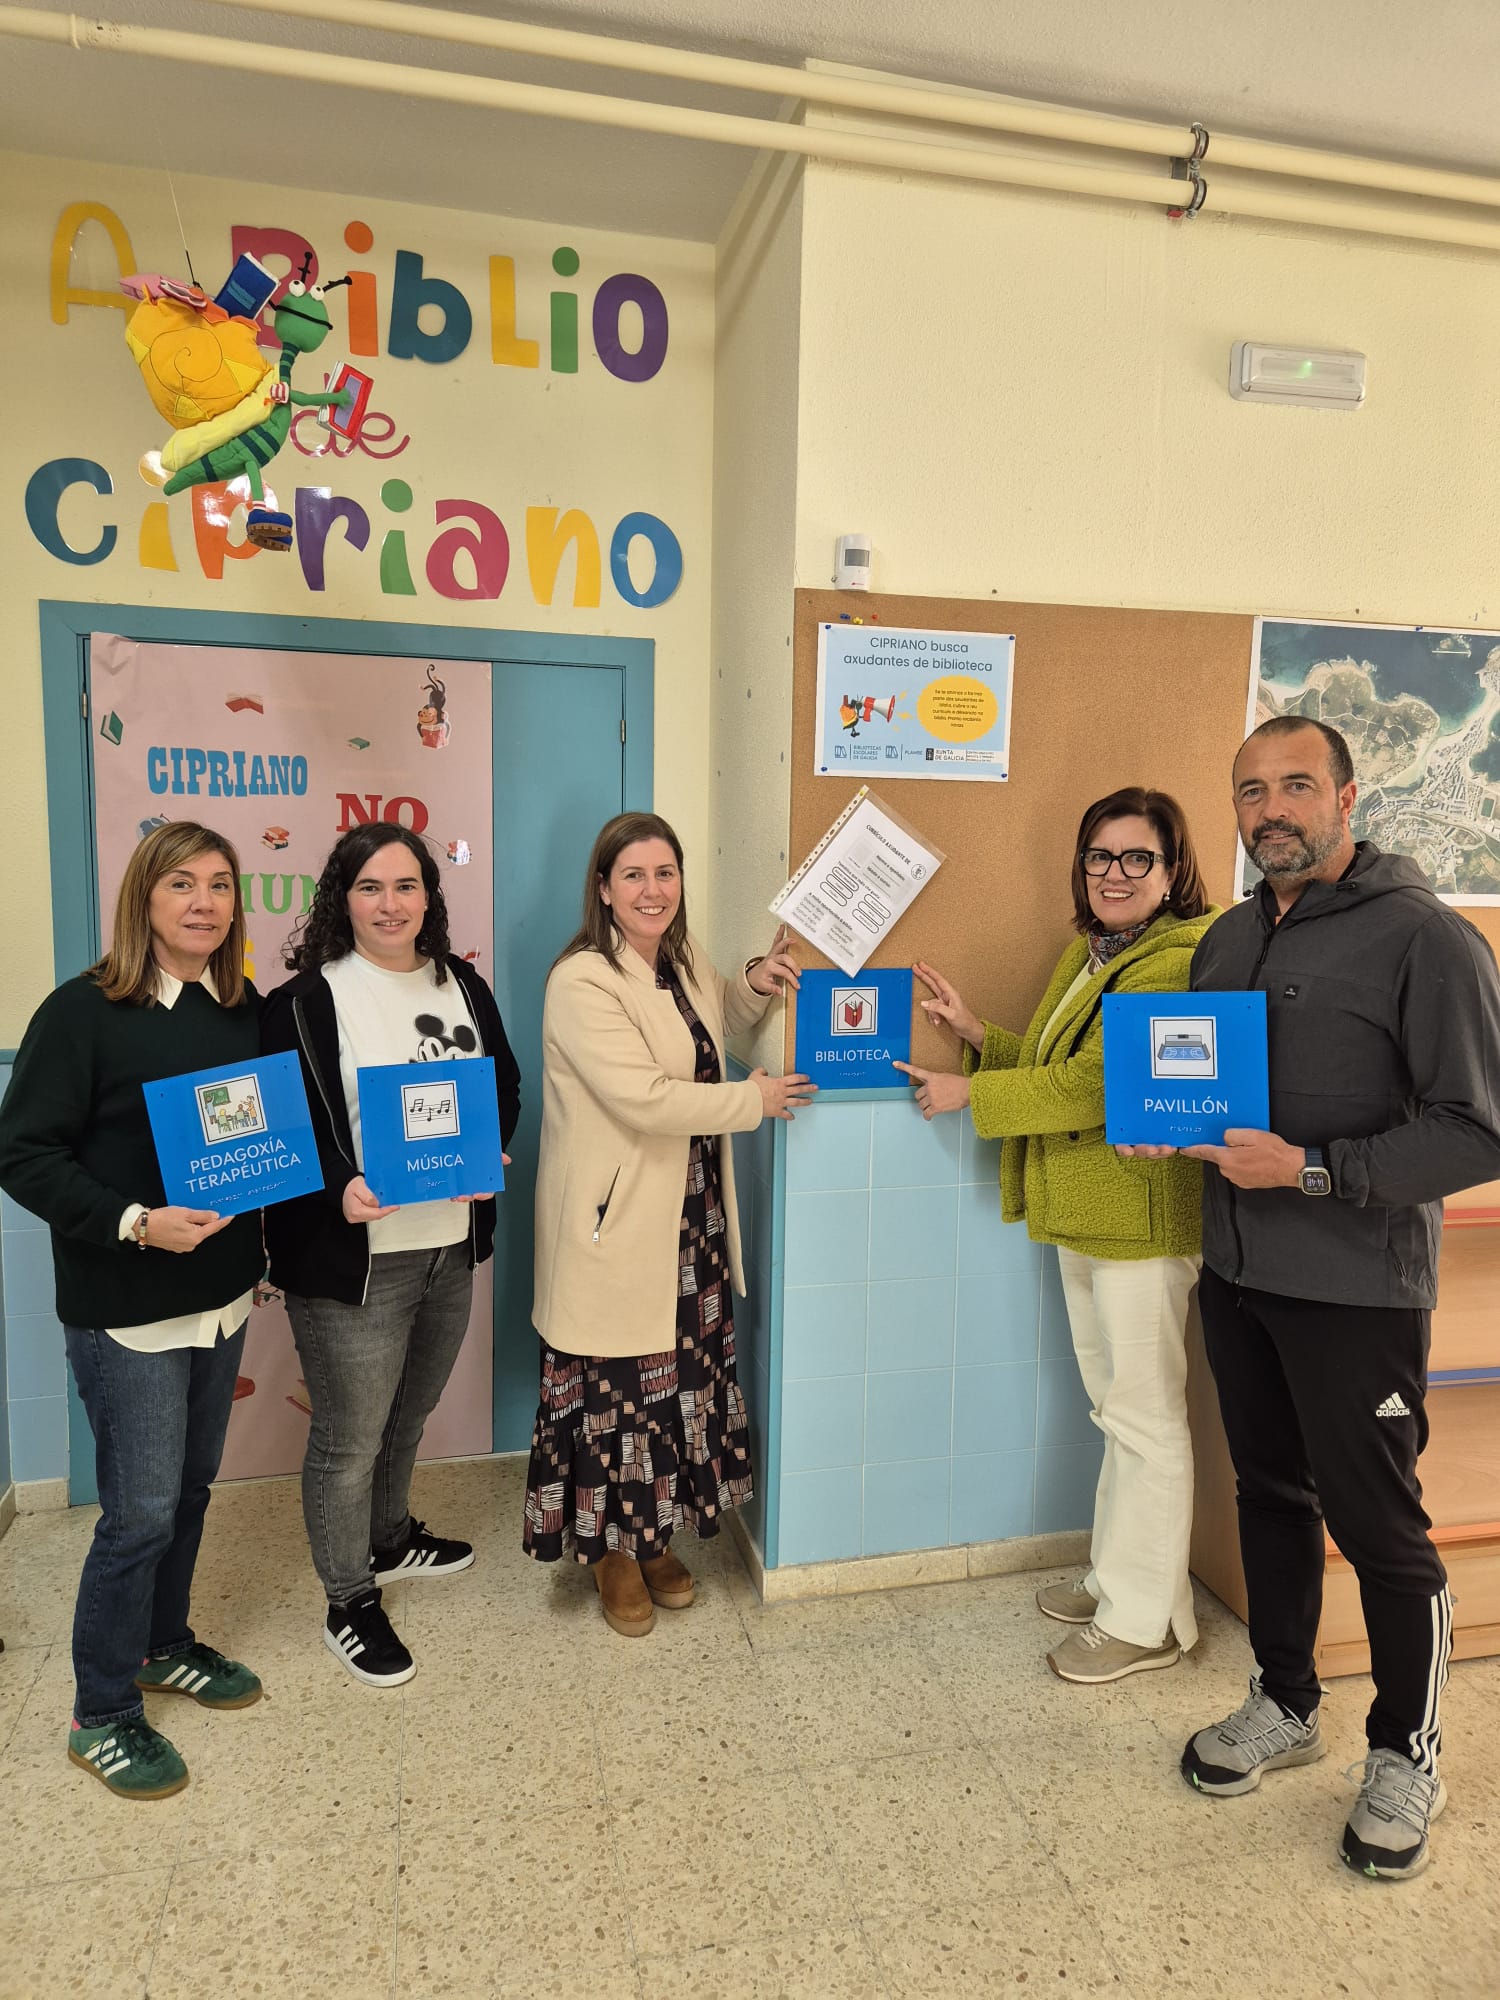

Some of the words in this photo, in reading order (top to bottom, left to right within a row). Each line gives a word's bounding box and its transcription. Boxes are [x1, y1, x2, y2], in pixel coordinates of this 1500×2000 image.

[50, 201, 138, 325] A
[290, 373, 410, 458] de
[870, 637, 927, 651] CIPRIANO
[930, 640, 969, 653] busca
[843, 654, 910, 667] axudantes
[913, 657, 929, 668] de
[932, 657, 993, 672] biblioteca
[147, 746, 308, 797] CIPRIANO
[336, 793, 429, 835] NO
[816, 1049, 890, 1062] BIBLIOTECA
[1144, 1096, 1228, 1114] PAVILLÓN
[190, 1136, 286, 1174] PEDAGOXÍA
[407, 1153, 464, 1172] MÚSICA
[185, 1153, 301, 1193] TERAPÉUTICA
[1376, 1408, 1410, 1416] adidas
